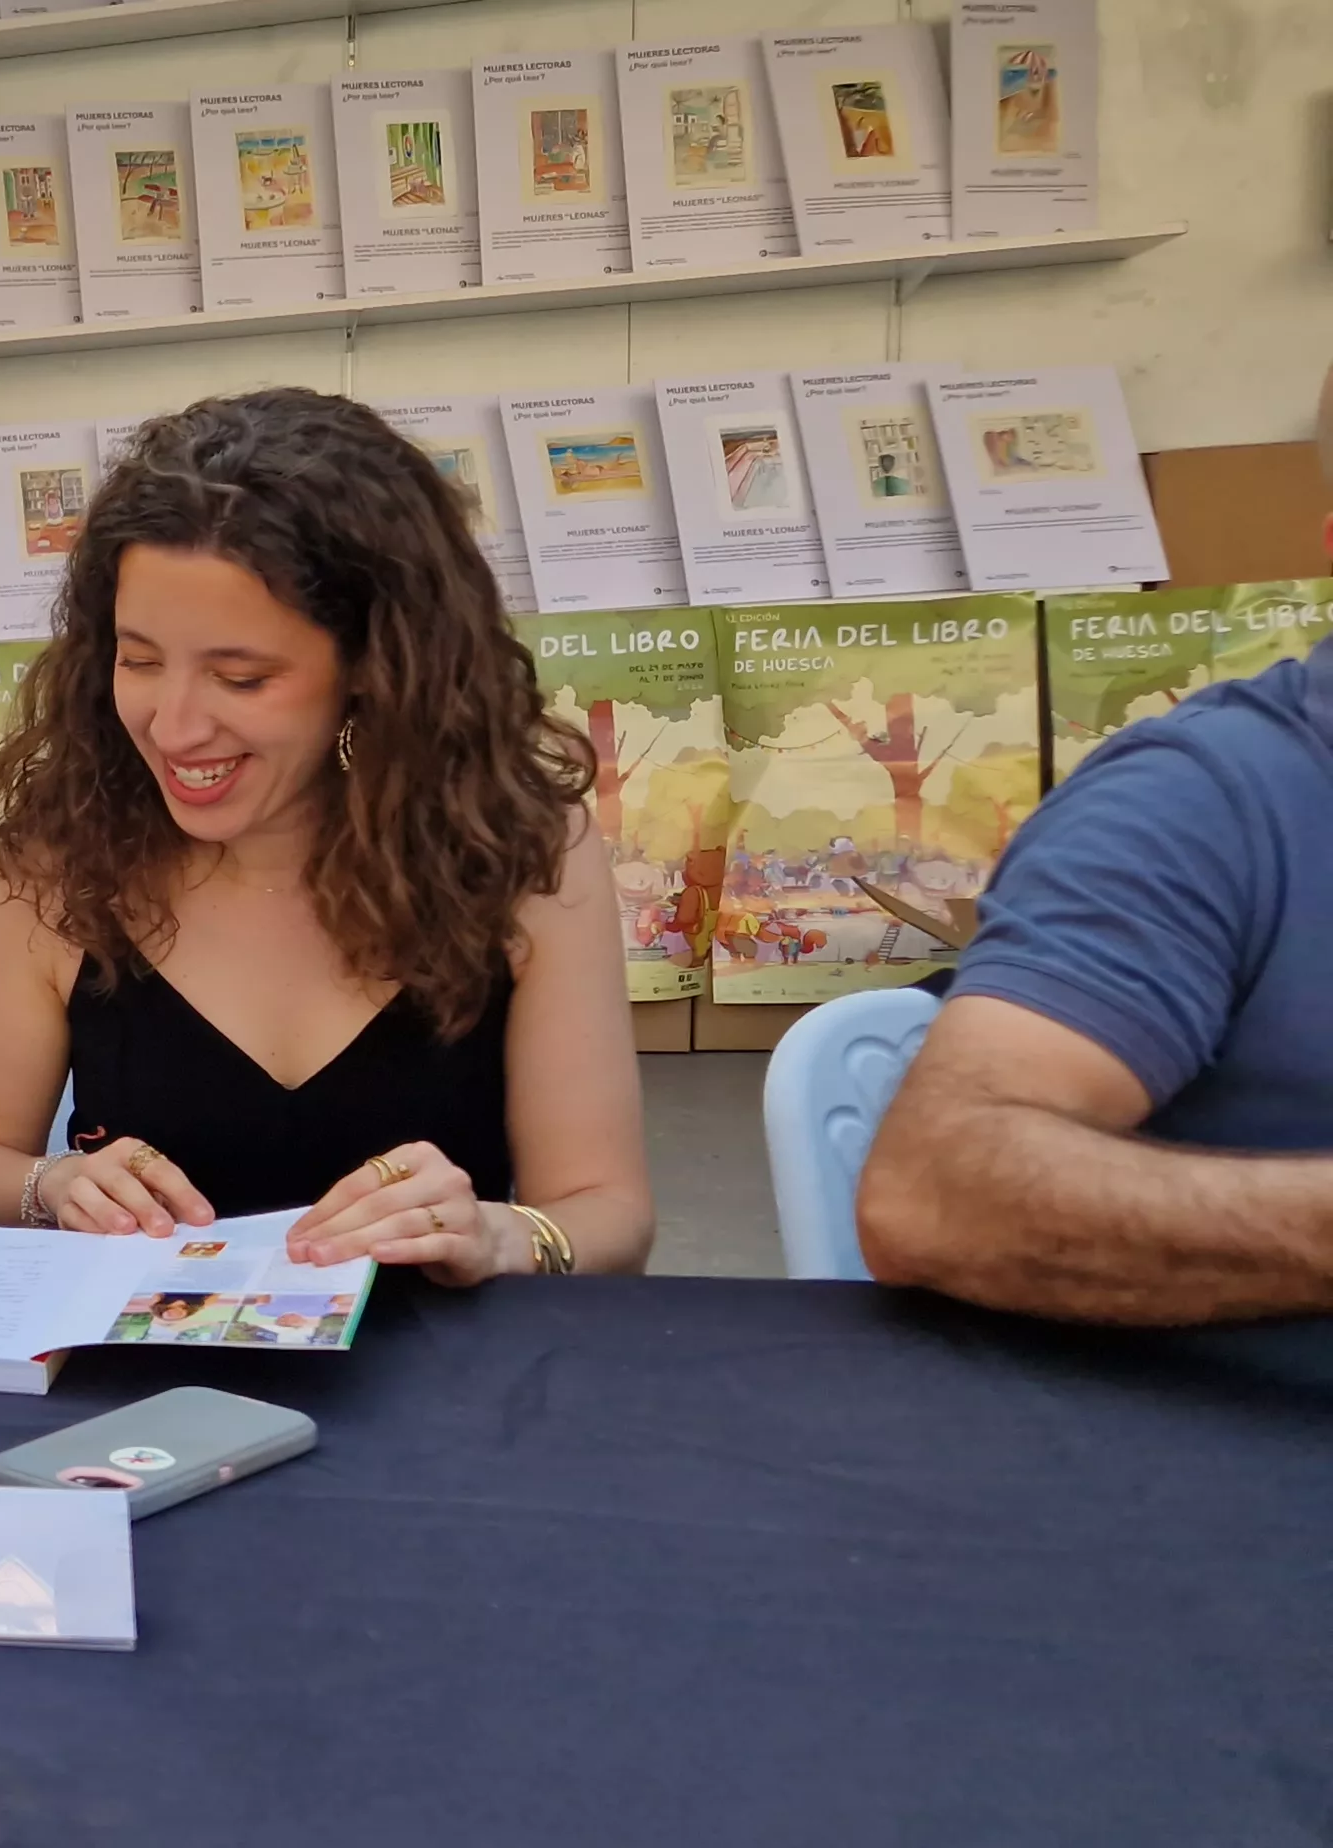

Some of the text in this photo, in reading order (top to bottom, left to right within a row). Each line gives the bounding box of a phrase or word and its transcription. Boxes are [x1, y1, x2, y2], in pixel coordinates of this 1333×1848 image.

[735, 617, 1009, 653] FERIA DEL LIBRO
[1071, 612, 1158, 640] FERIA
[1170, 610, 1232, 633] DEL
[540, 629, 701, 658] DEL LIBRO
[1073, 643, 1173, 662] DE HUESCA
[629, 665, 645, 673] DEL
[734, 655, 834, 673] DE HUESCA
